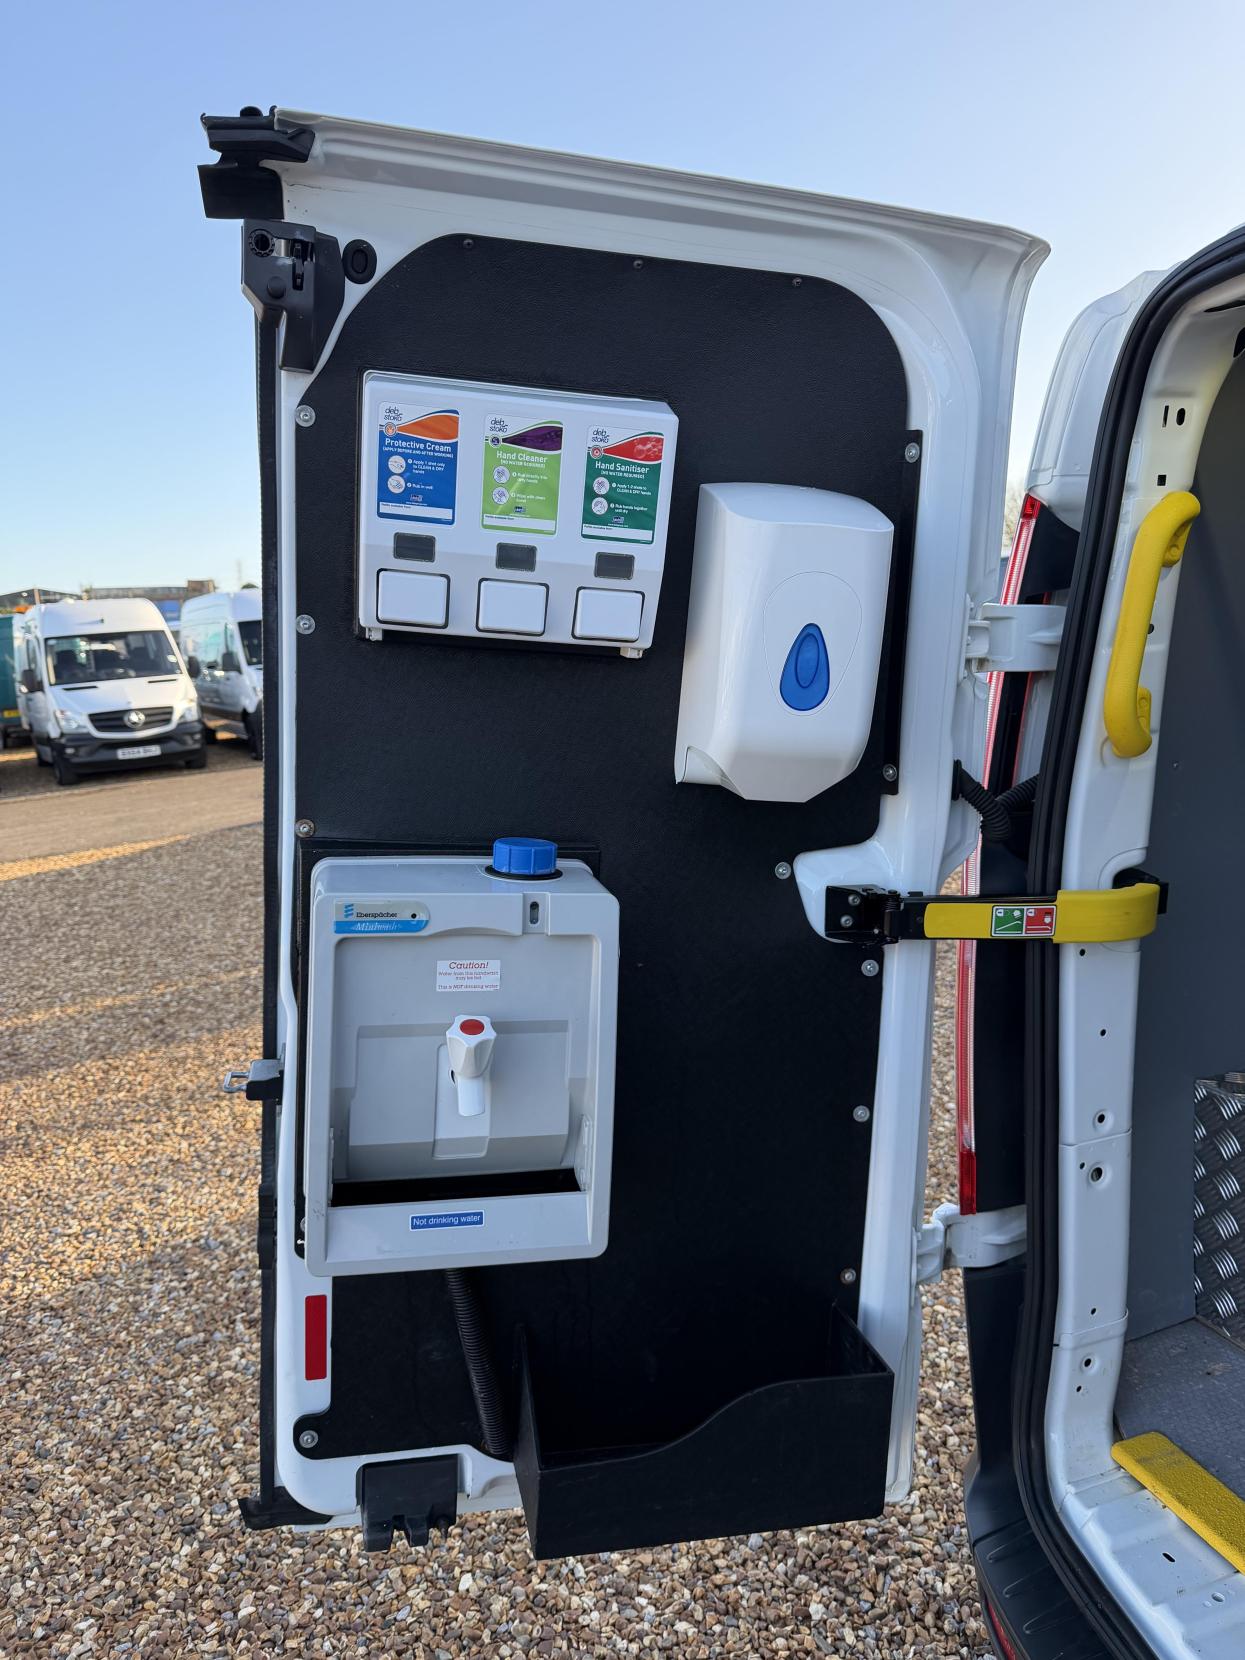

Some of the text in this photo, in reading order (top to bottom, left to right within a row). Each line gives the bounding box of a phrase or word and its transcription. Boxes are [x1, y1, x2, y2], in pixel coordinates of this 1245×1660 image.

[385, 406, 399, 414] deb
[489, 424, 508, 433] stoko
[593, 428, 606, 436] deb
[385, 438, 452, 452] Protective Cream
[497, 451, 548, 463] Hand Cleaner
[595, 461, 650, 474] Hand Sanitiser
[449, 961, 489, 969] Caution!
[413, 1217, 427, 1226] Not
[428, 1216, 459, 1225] drinking
